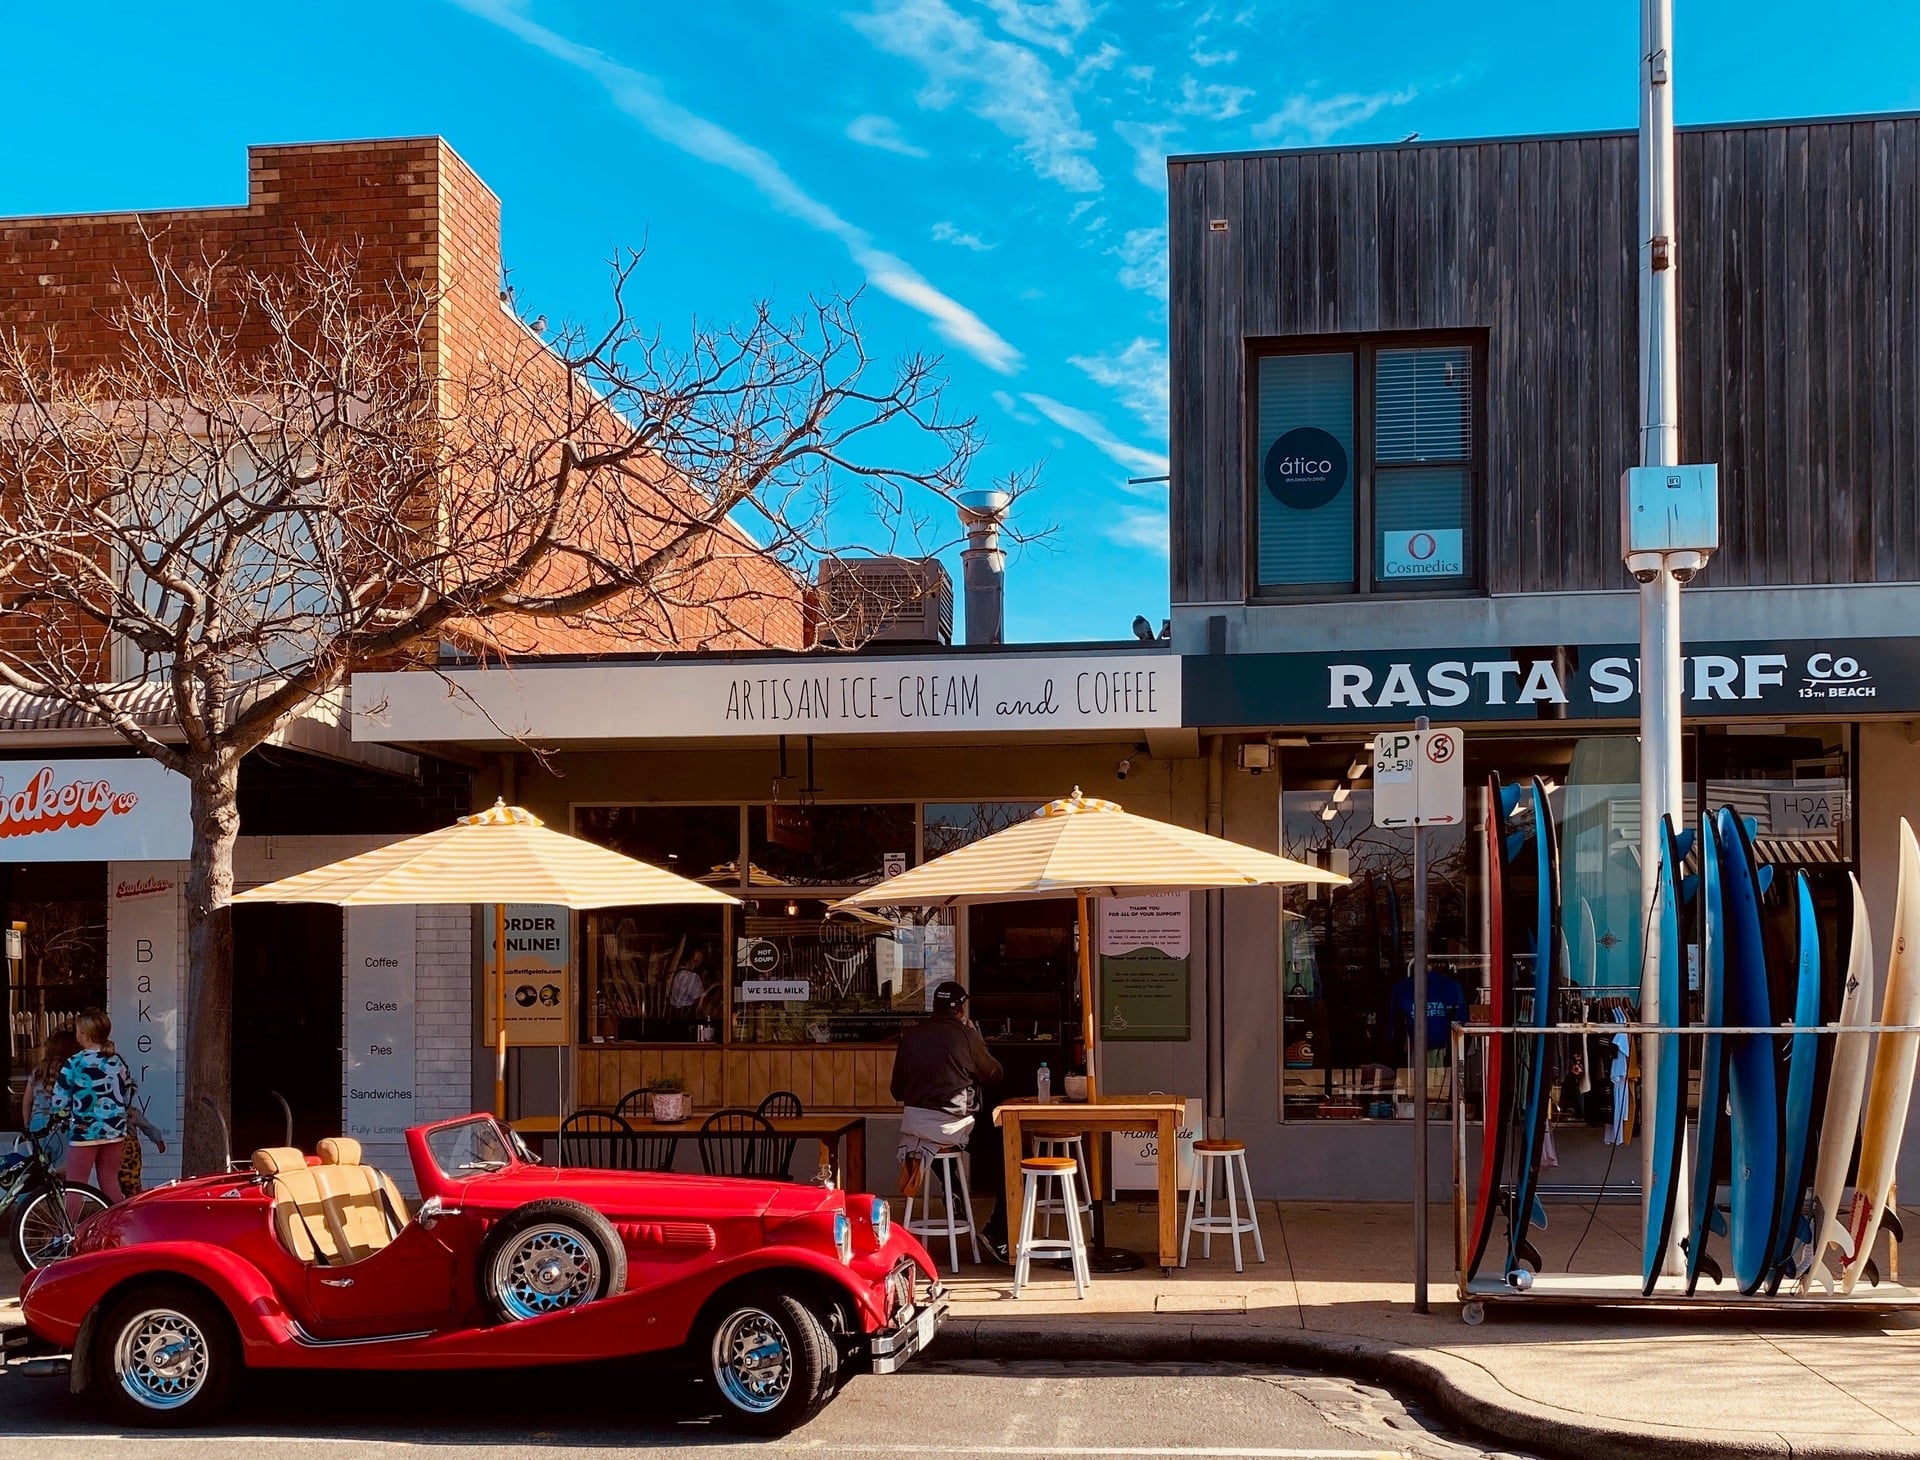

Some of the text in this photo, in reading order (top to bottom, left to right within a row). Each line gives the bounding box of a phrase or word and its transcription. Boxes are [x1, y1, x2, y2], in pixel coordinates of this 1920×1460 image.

[1279, 456, 1332, 475] ático
[1408, 533, 1436, 560] O
[1386, 559, 1459, 574] Cosmedics
[1327, 660, 1569, 709] RASTA
[725, 671, 1157, 720] ARTISAN ICE-CREAM and COFFEE
[1828, 686, 1876, 698] BEACH
[493, 937, 561, 951] NLINE!
[365, 957, 398, 968] Coffee
[365, 1001, 397, 1012] Cakes
[136, 939, 153, 1116] Bakery
[370, 1045, 392, 1055] Pies
[350, 1088, 412, 1100] Sandwiches
[351, 1124, 370, 1136] Fully
[1120, 1127, 1193, 1139] Homede
